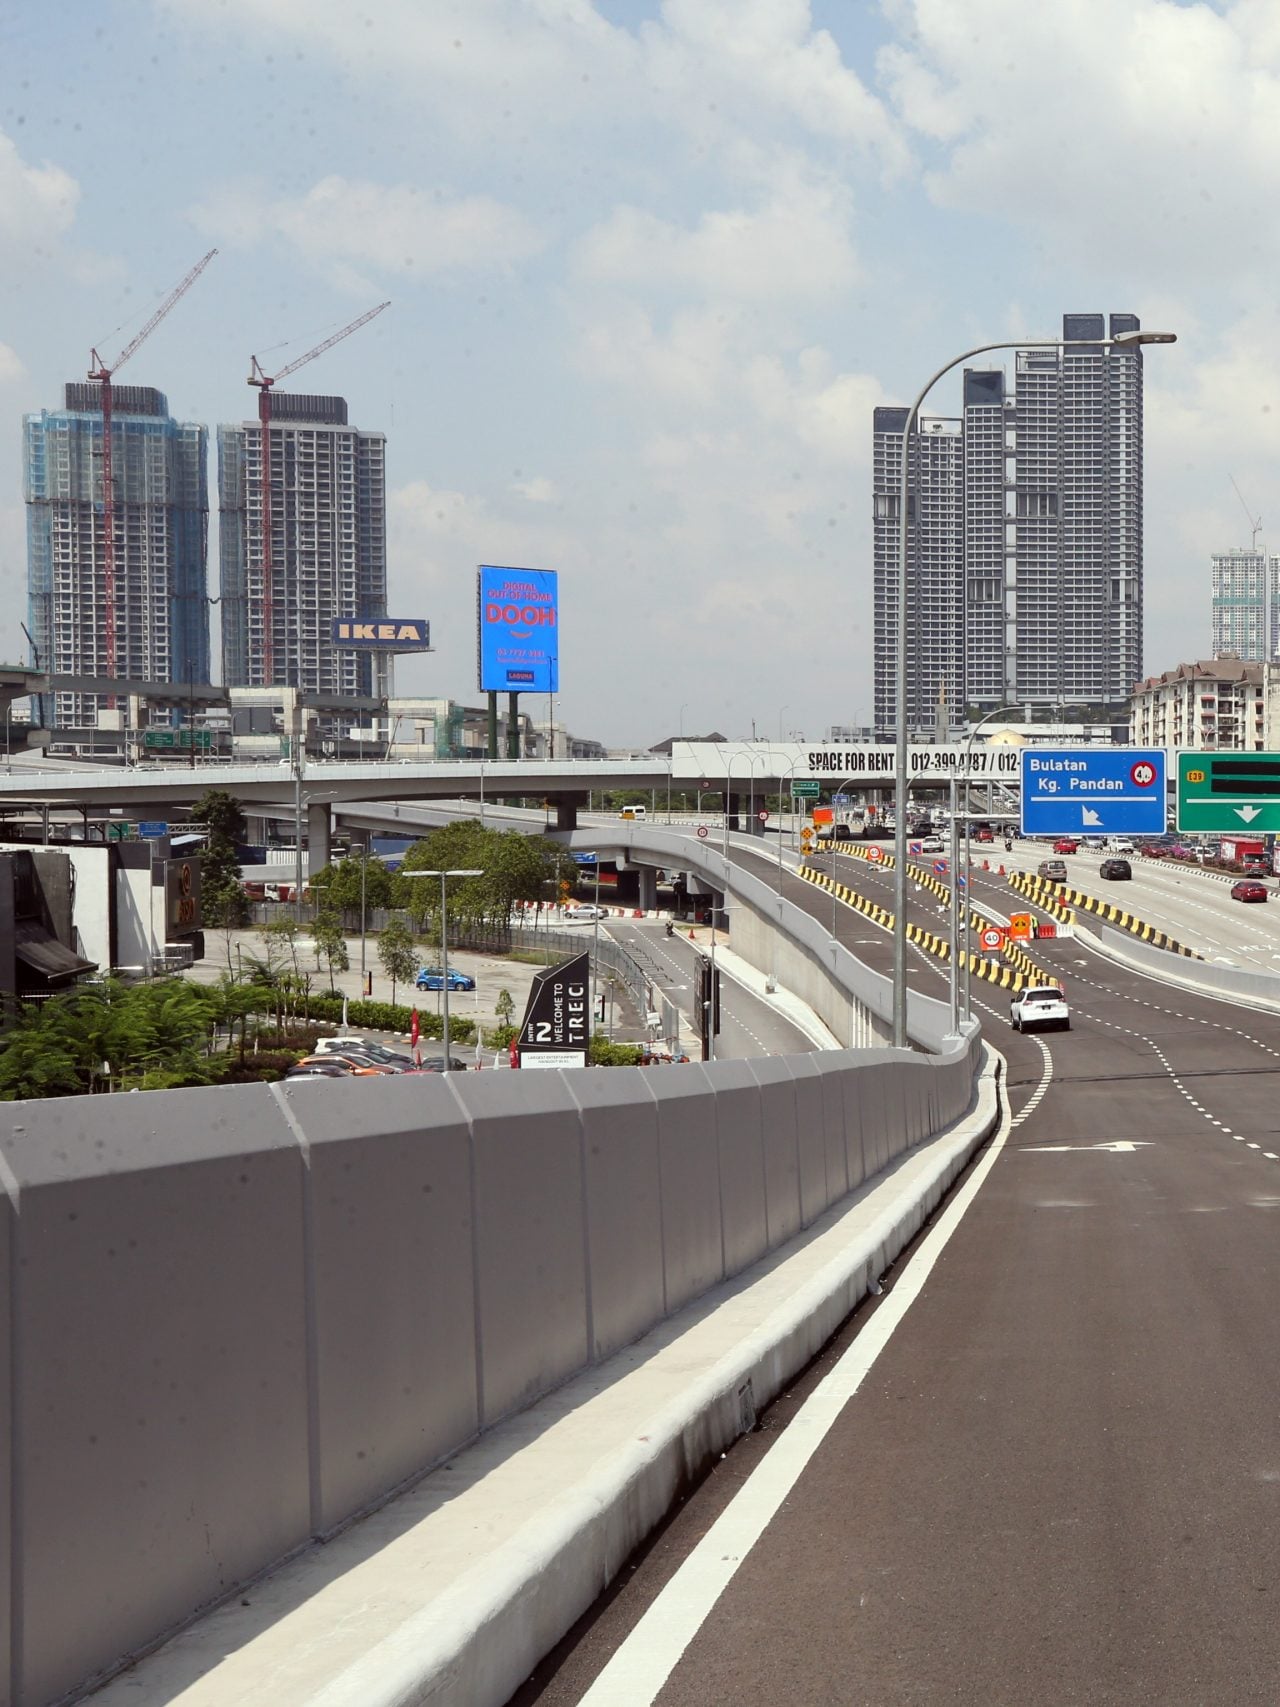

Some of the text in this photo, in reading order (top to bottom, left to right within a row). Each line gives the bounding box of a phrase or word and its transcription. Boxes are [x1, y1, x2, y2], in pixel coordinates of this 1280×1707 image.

[503, 581, 537, 592] DIGITAL
[486, 604, 555, 626] DOOH
[339, 624, 421, 640] IKEA
[808, 752, 843, 771] SPACE
[845, 752, 865, 771] FOR
[868, 752, 895, 771] RENT
[1030, 759, 1087, 771] Bulatan
[1188, 772, 1203, 781] E39
[1038, 778, 1123, 792] Kg. Pandan
[986, 934, 998, 942] 40
[554, 983, 563, 1043] WELCOME TO
[568, 986, 584, 1043] TREC
[536, 1022, 552, 1042] 2
